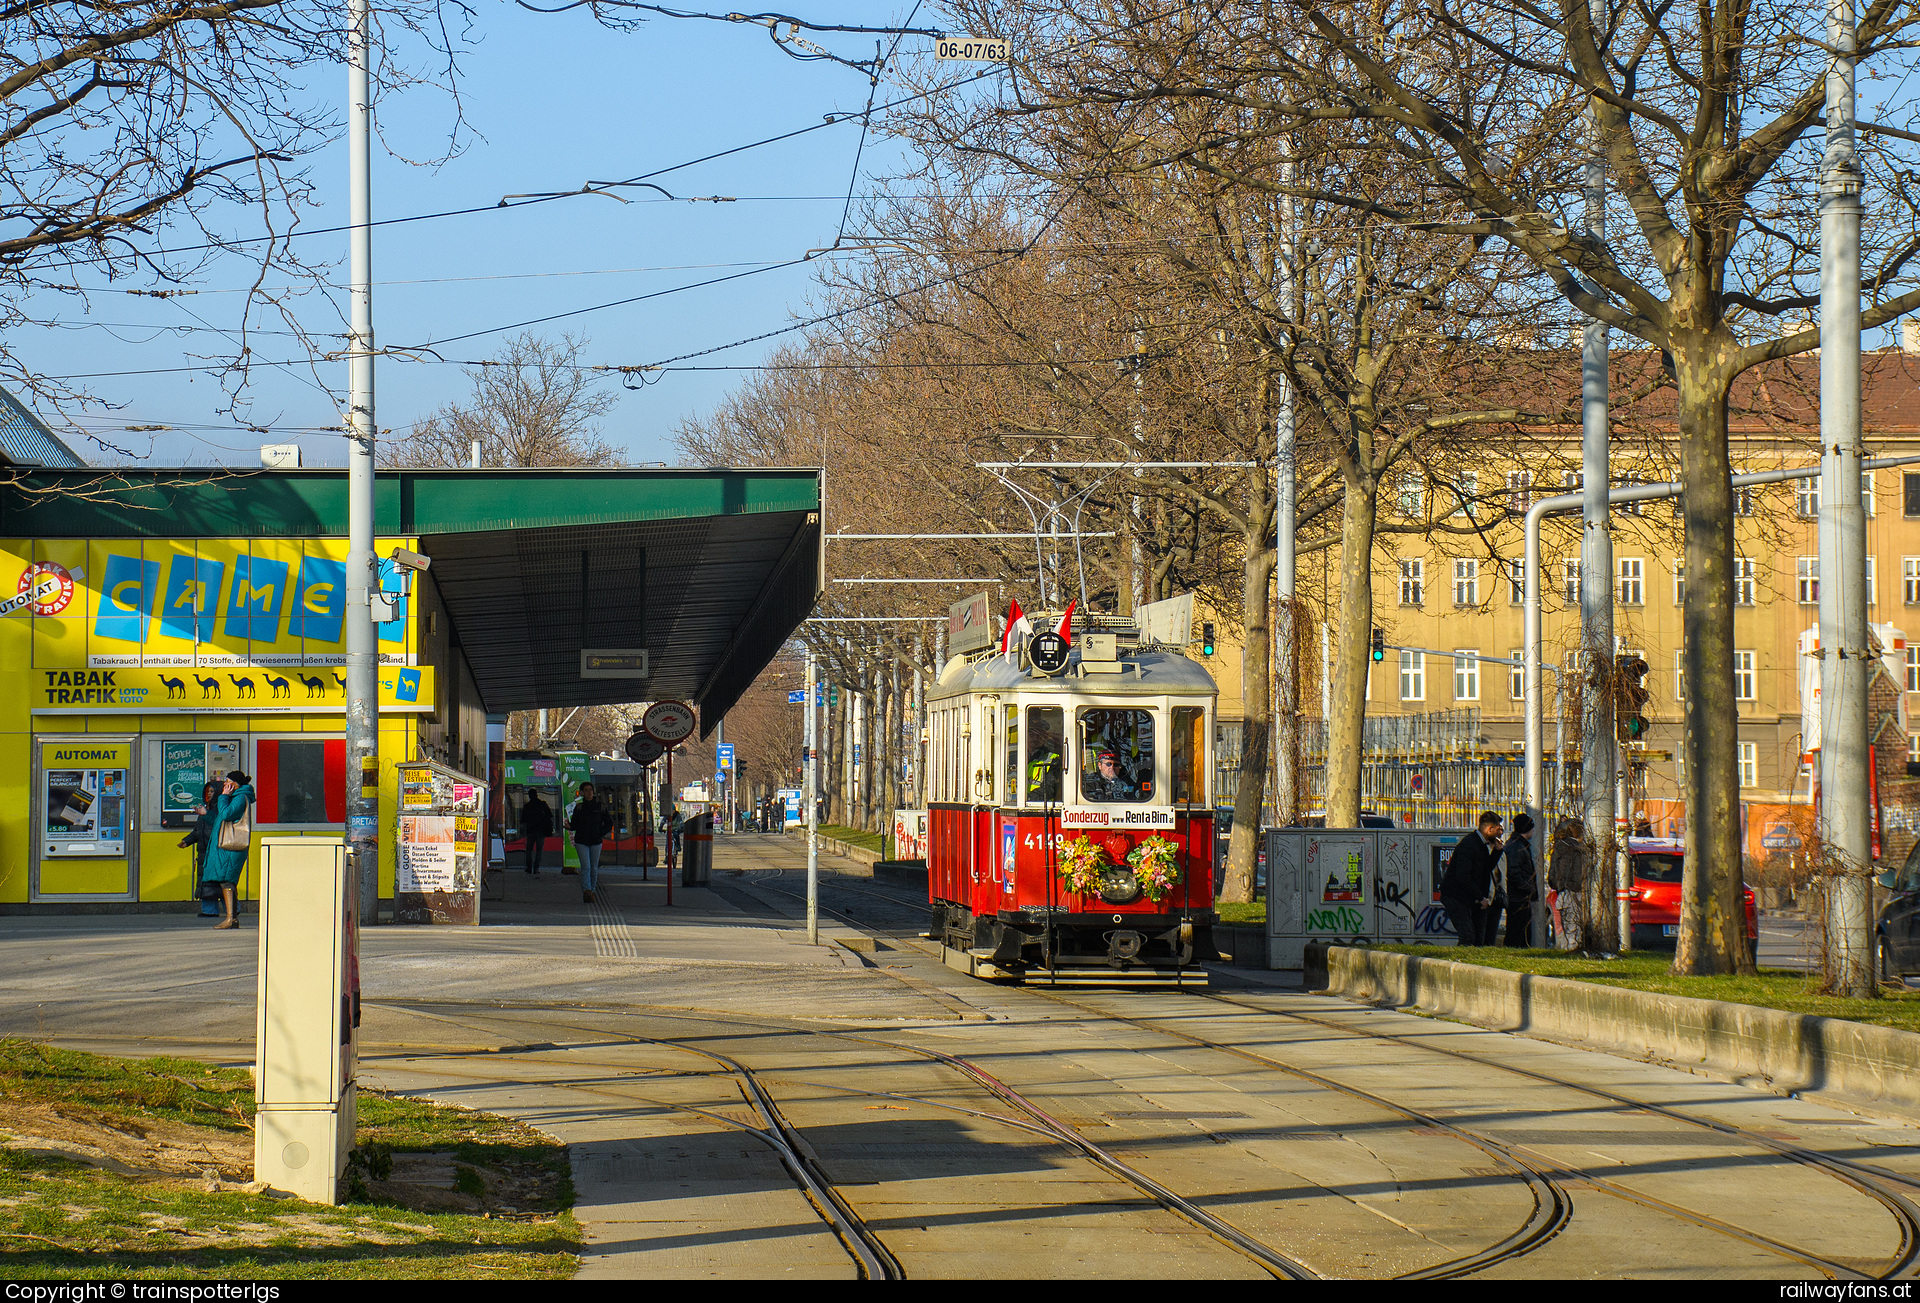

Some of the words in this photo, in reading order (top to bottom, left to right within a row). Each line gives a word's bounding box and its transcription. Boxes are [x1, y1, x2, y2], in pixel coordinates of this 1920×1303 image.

[939, 42, 1006, 60] 06-07/63
[20, 563, 64, 590] TABAK
[0, 581, 53, 614] UTOMAT
[34, 579, 72, 614] TRAFIK
[111, 578, 335, 614] CAME
[93, 657, 139, 665] Tabakrauch
[144, 657, 171, 665] enthält
[173, 657, 191, 665] über
[199, 657, 208, 665] 70
[209, 657, 234, 666] Stoffe,
[235, 657, 248, 665] die
[252, 657, 324, 665] erwiesenermaßen
[326, 657, 347, 665] krebs
[45, 671, 117, 687] TABAK
[45, 688, 117, 704] TRAFIK
[119, 688, 149, 696] LOTTO
[649, 705, 691, 720] STRASSENBAHN
[650, 725, 688, 738] HALTESTELLE
[54, 750, 118, 760] AUTOMAT
[1063, 810, 1110, 826] Sonderzug
[1024, 833, 1064, 850] 4149
